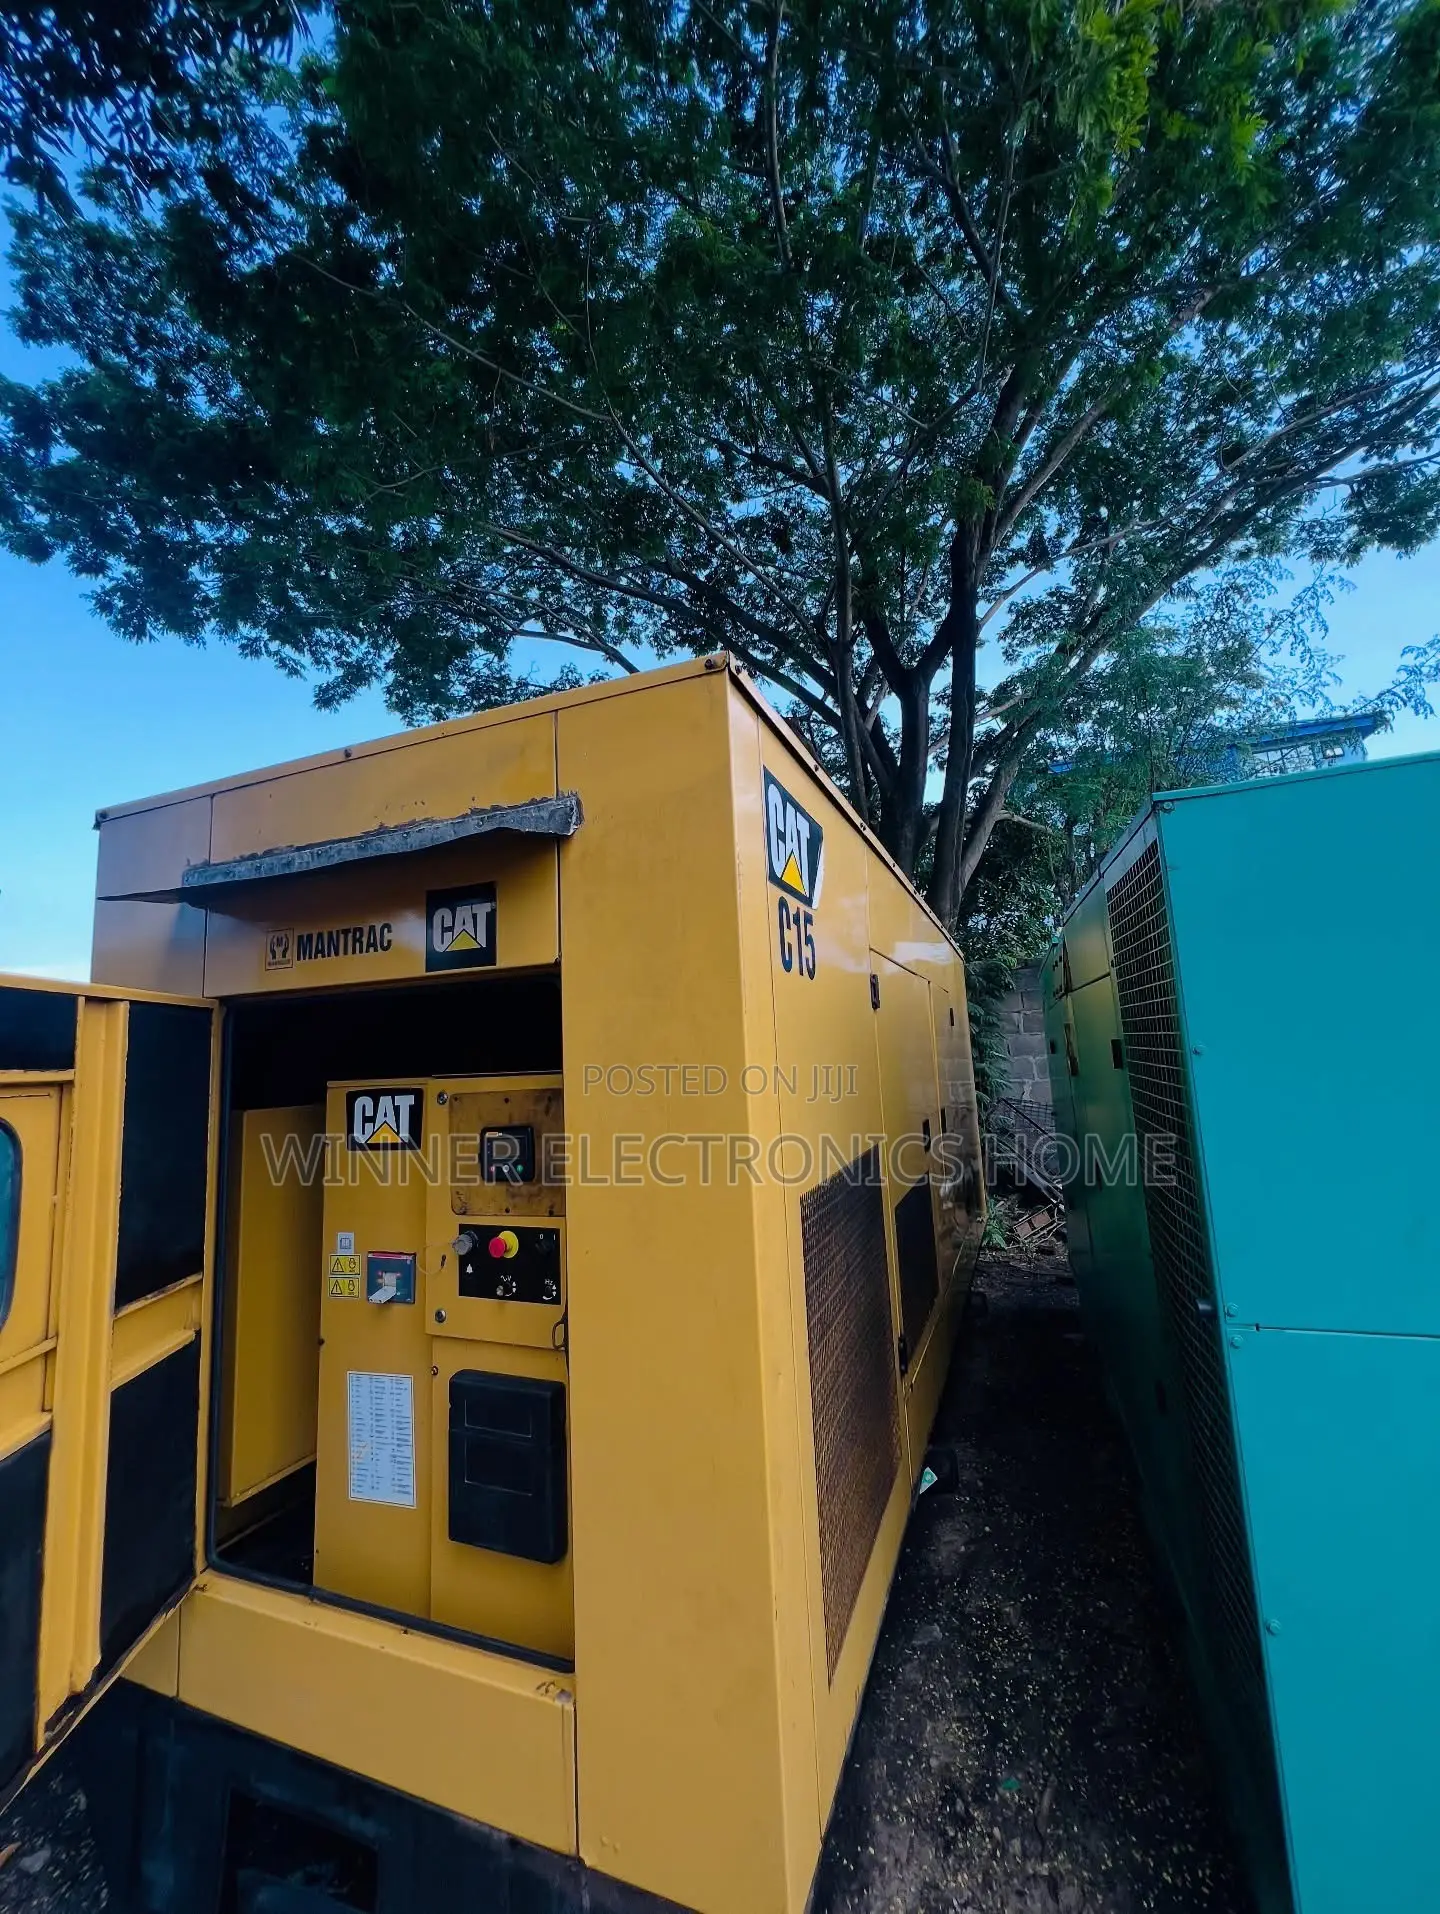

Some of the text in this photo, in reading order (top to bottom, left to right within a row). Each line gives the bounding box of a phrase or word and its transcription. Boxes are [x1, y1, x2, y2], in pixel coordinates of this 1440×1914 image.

[767, 783, 810, 898] CAT
[296, 922, 393, 962] MANTRAC
[432, 902, 491, 952] CAT
[778, 896, 816, 980] C15
[353, 1094, 415, 1144] CAT
